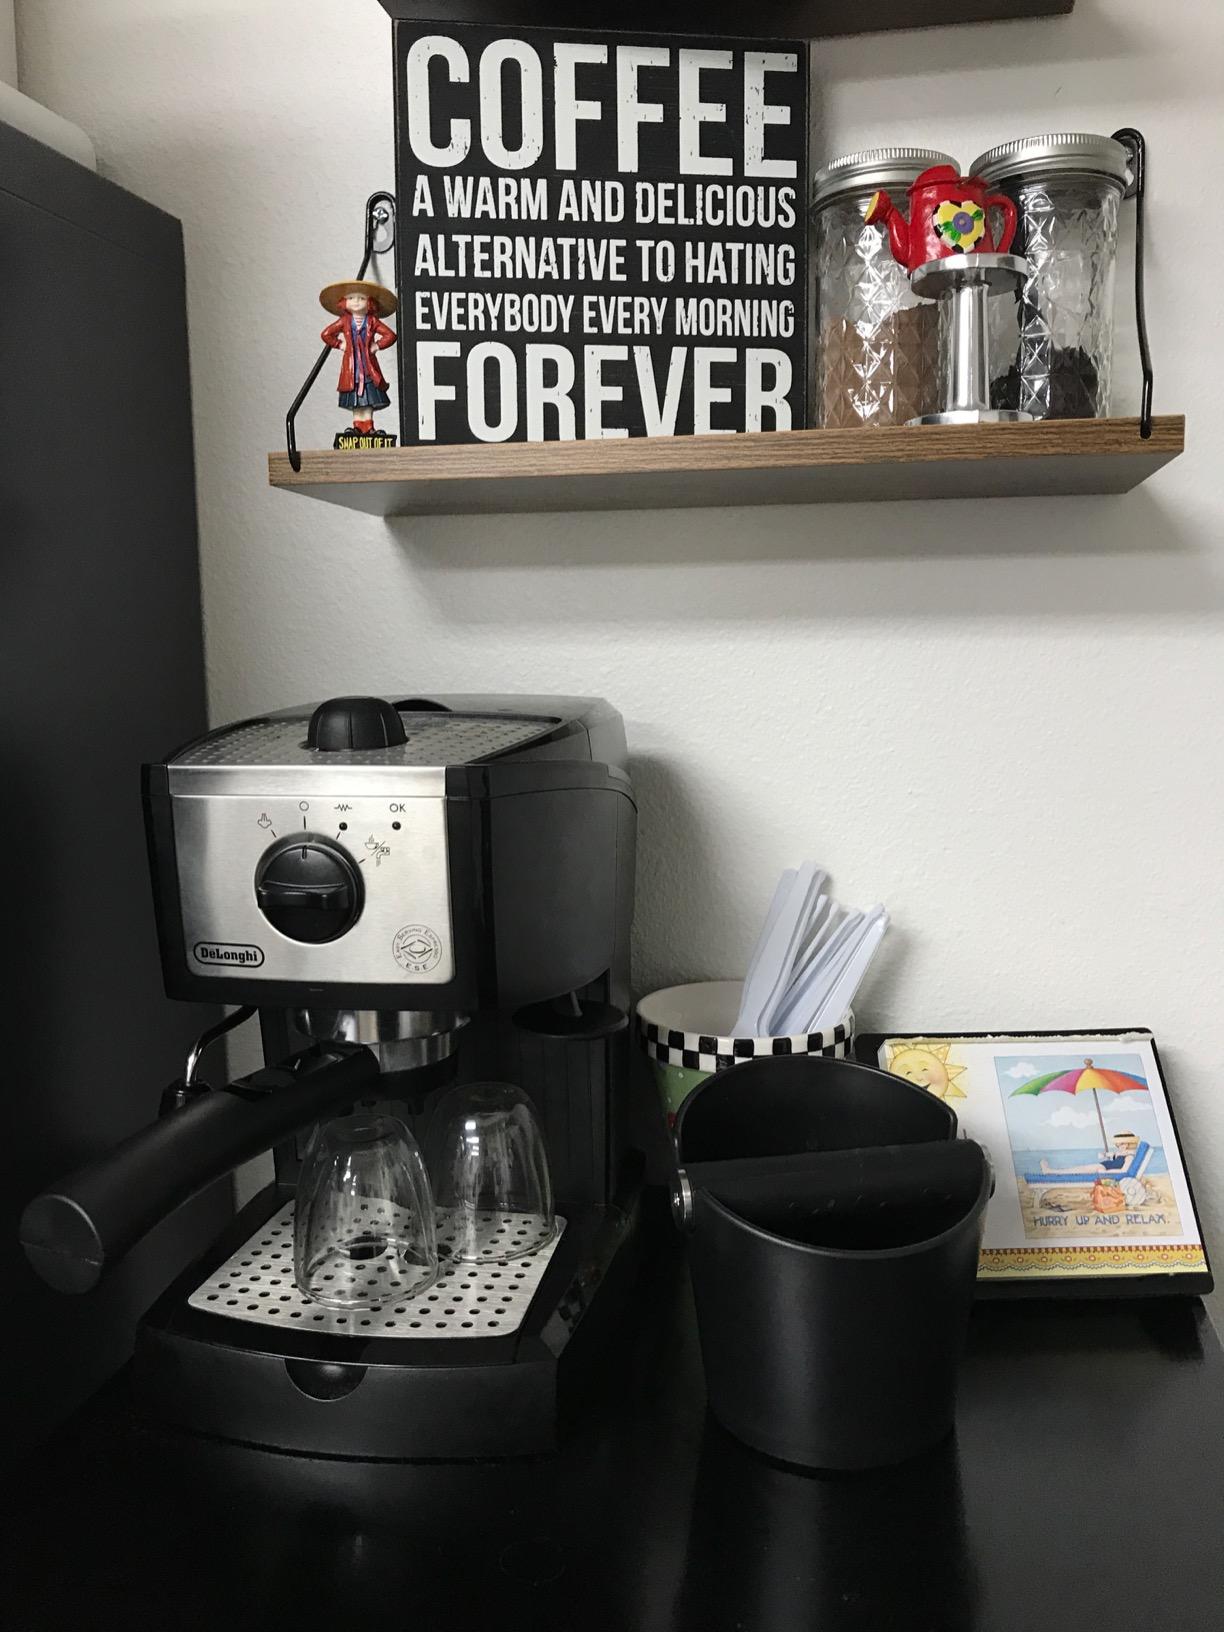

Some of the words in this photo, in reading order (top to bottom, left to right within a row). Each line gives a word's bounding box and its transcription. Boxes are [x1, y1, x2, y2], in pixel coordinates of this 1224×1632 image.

[406, 34, 798, 179] COFFEE
[412, 174, 435, 218] A
[443, 175, 548, 221] WARM
[558, 179, 625, 224] AND
[635, 181, 797, 229] DELICIOUS
[414, 233, 627, 282] ALTERNATIVE
[635, 240, 676, 283] TO
[685, 241, 796, 287] HATING
[415, 291, 575, 334] EVERYBODY
[583, 295, 668, 335] EVERY
[675, 298, 796, 338] MORNING
[415, 341, 793, 443] FOREVER
[338, 436, 359, 449] SNAP
[359, 436, 373, 449] OUT
[373, 437, 384, 449] OF
[384, 438, 393, 448] IT
[389, 803, 406, 812] OK
[200, 947, 258, 964] DeLonghi
[1033, 1214, 1069, 1227] HURRY
[1075, 1215, 1090, 1226] UP
[1094, 1214, 1121, 1226] AND
